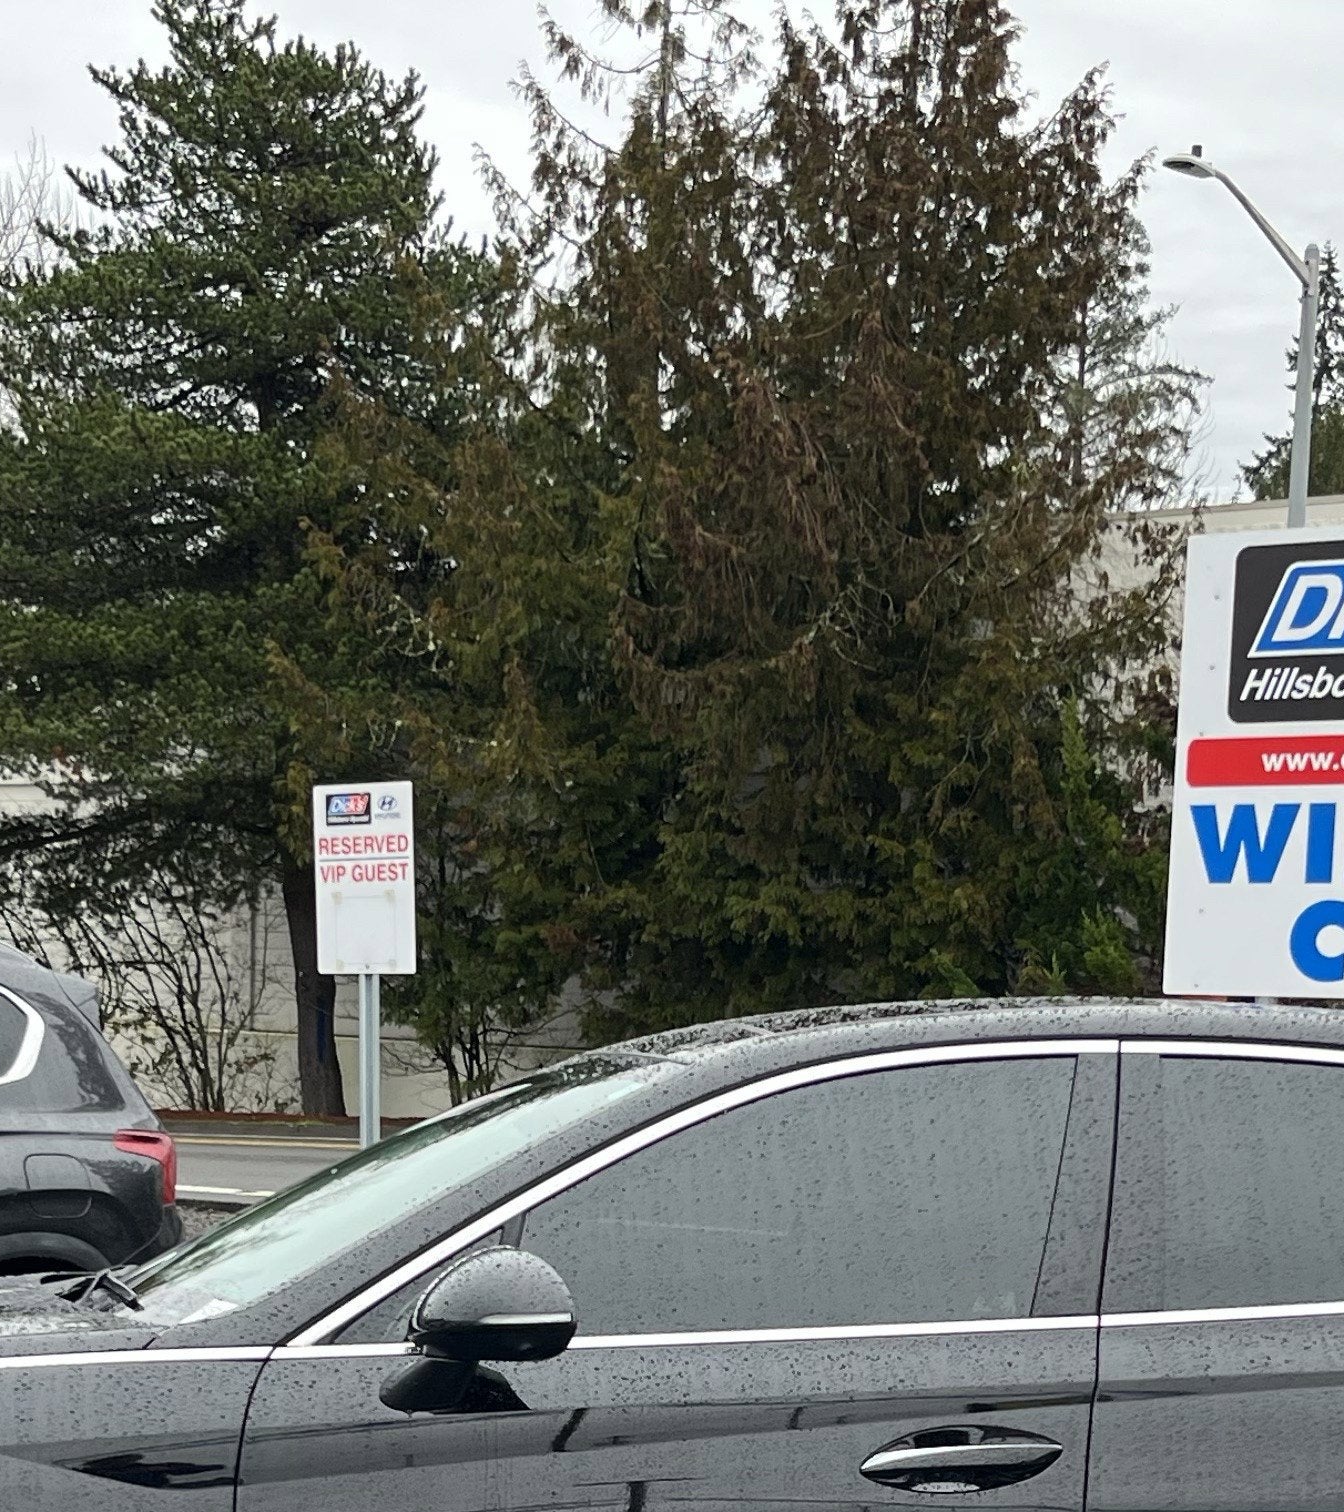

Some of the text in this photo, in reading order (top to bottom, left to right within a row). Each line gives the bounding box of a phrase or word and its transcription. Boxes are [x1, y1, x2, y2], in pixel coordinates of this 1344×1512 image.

[318, 834, 409, 855] RESERVED
[320, 863, 409, 883] VIP GUEST
